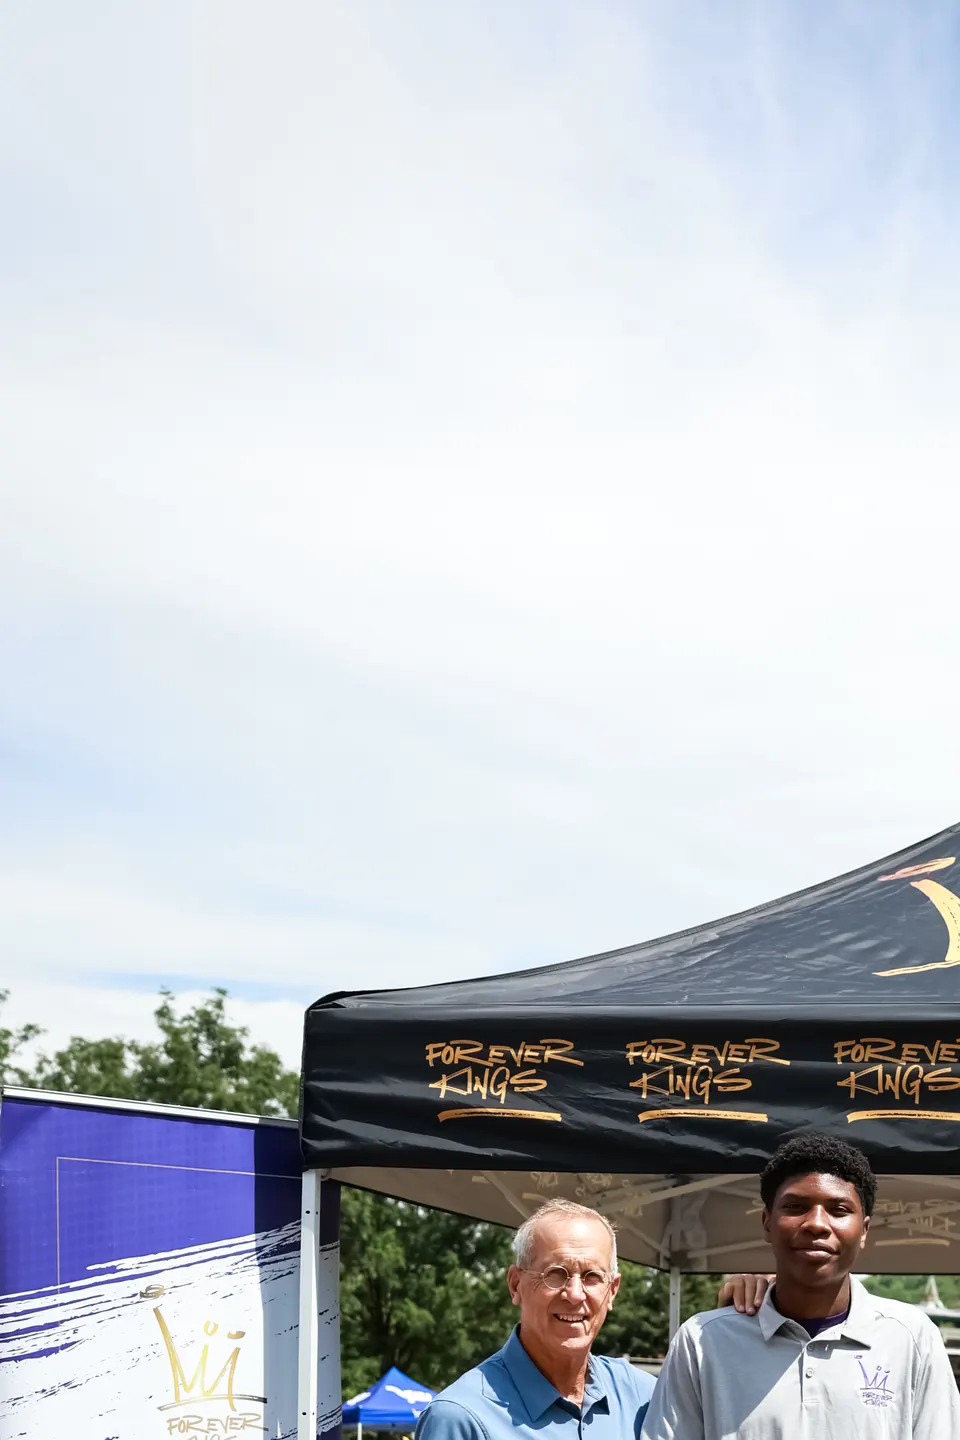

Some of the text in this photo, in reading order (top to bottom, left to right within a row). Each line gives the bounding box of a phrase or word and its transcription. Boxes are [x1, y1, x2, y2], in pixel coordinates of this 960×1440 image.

[426, 1039, 584, 1067] FOREVER
[626, 1039, 790, 1066] FOREVER
[428, 1065, 548, 1104] KINGS
[629, 1064, 753, 1105] KINGS
[166, 1412, 270, 1435] FOREVER
